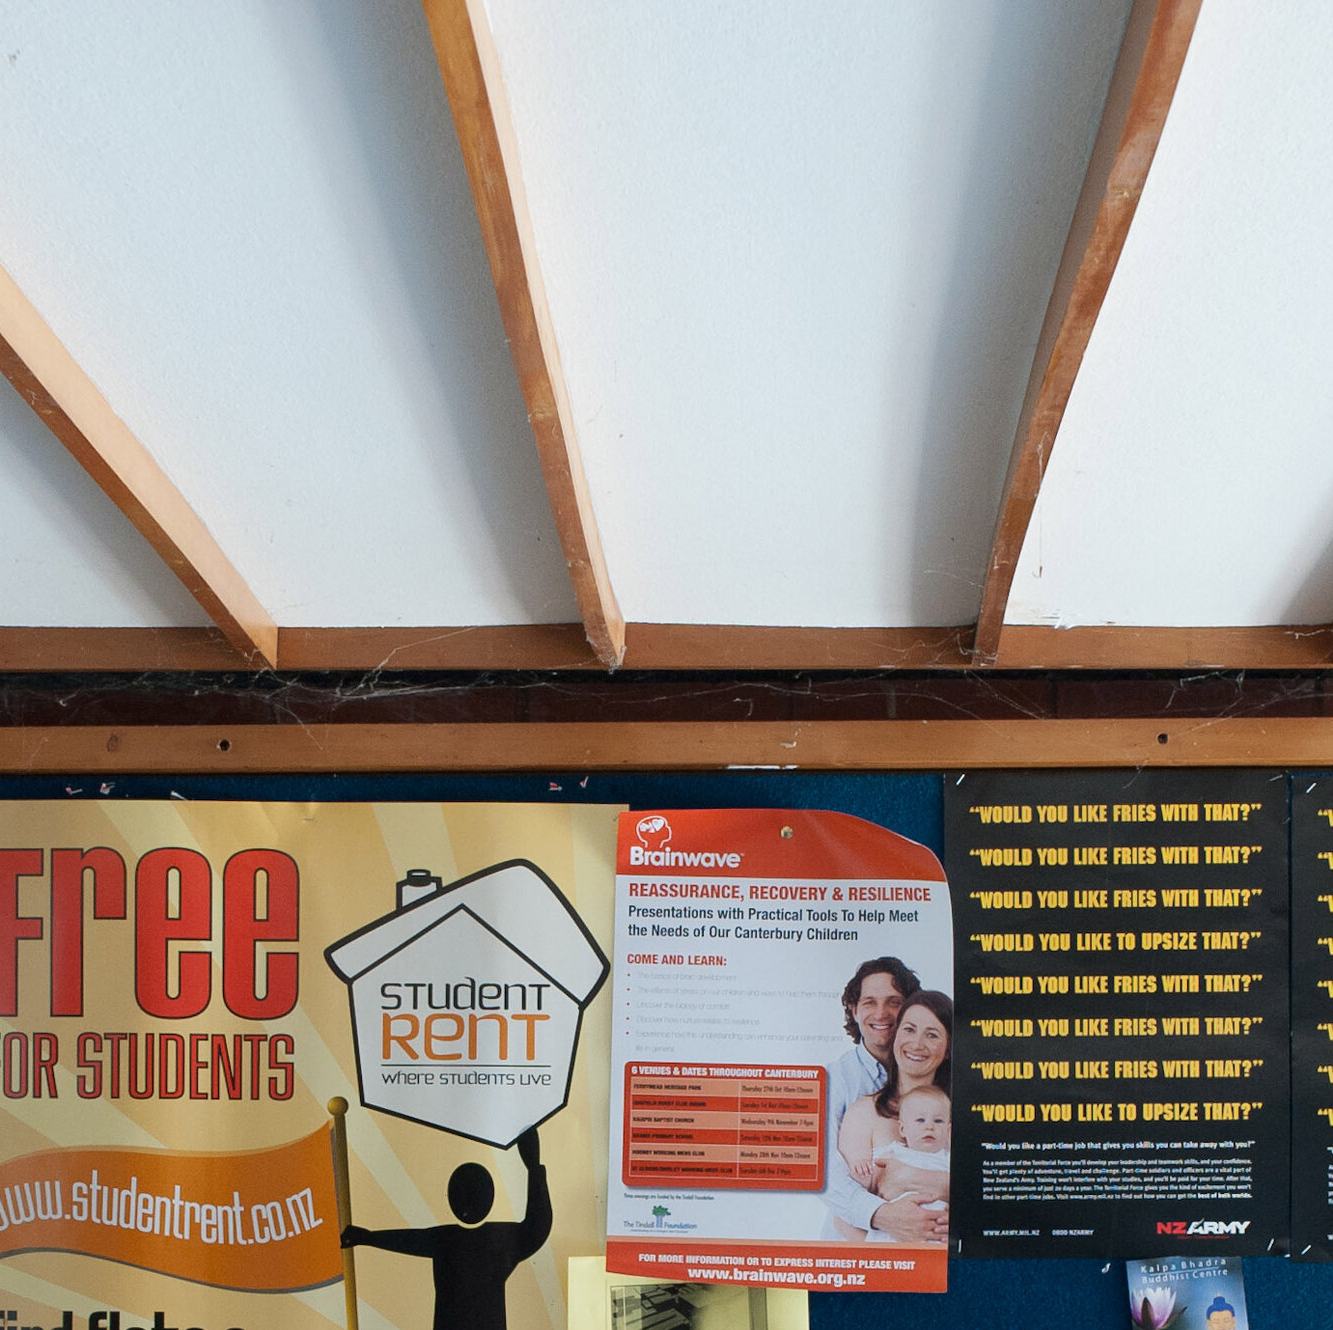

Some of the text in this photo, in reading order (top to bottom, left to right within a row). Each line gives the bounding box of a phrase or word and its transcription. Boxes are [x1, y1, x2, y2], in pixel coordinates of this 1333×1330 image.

[1036, 805, 1067, 822] YOU
[1074, 805, 1107, 822] LIKE
[1113, 804, 1156, 822] FRIES
[1161, 804, 1198, 821] WITH
[630, 846, 741, 868] Brainwave
[629, 883, 931, 901] REASSURANCE, RECOVERY & RESILIENCE
[629, 905, 918, 924] Presentations with Practical Tools To Help Meet
[628, 924, 857, 942] the Needs of Our Canterbury Children
[627, 954, 726, 965] COME AND LEARN:
[77, 1032, 294, 1101] STUDENTS
[1181, 1259, 1226, 1270] Bhadra
[688, 1268, 865, 1286] www.brainwave.org.nz
[1141, 1269, 1228, 1284] Buddhist Centre
